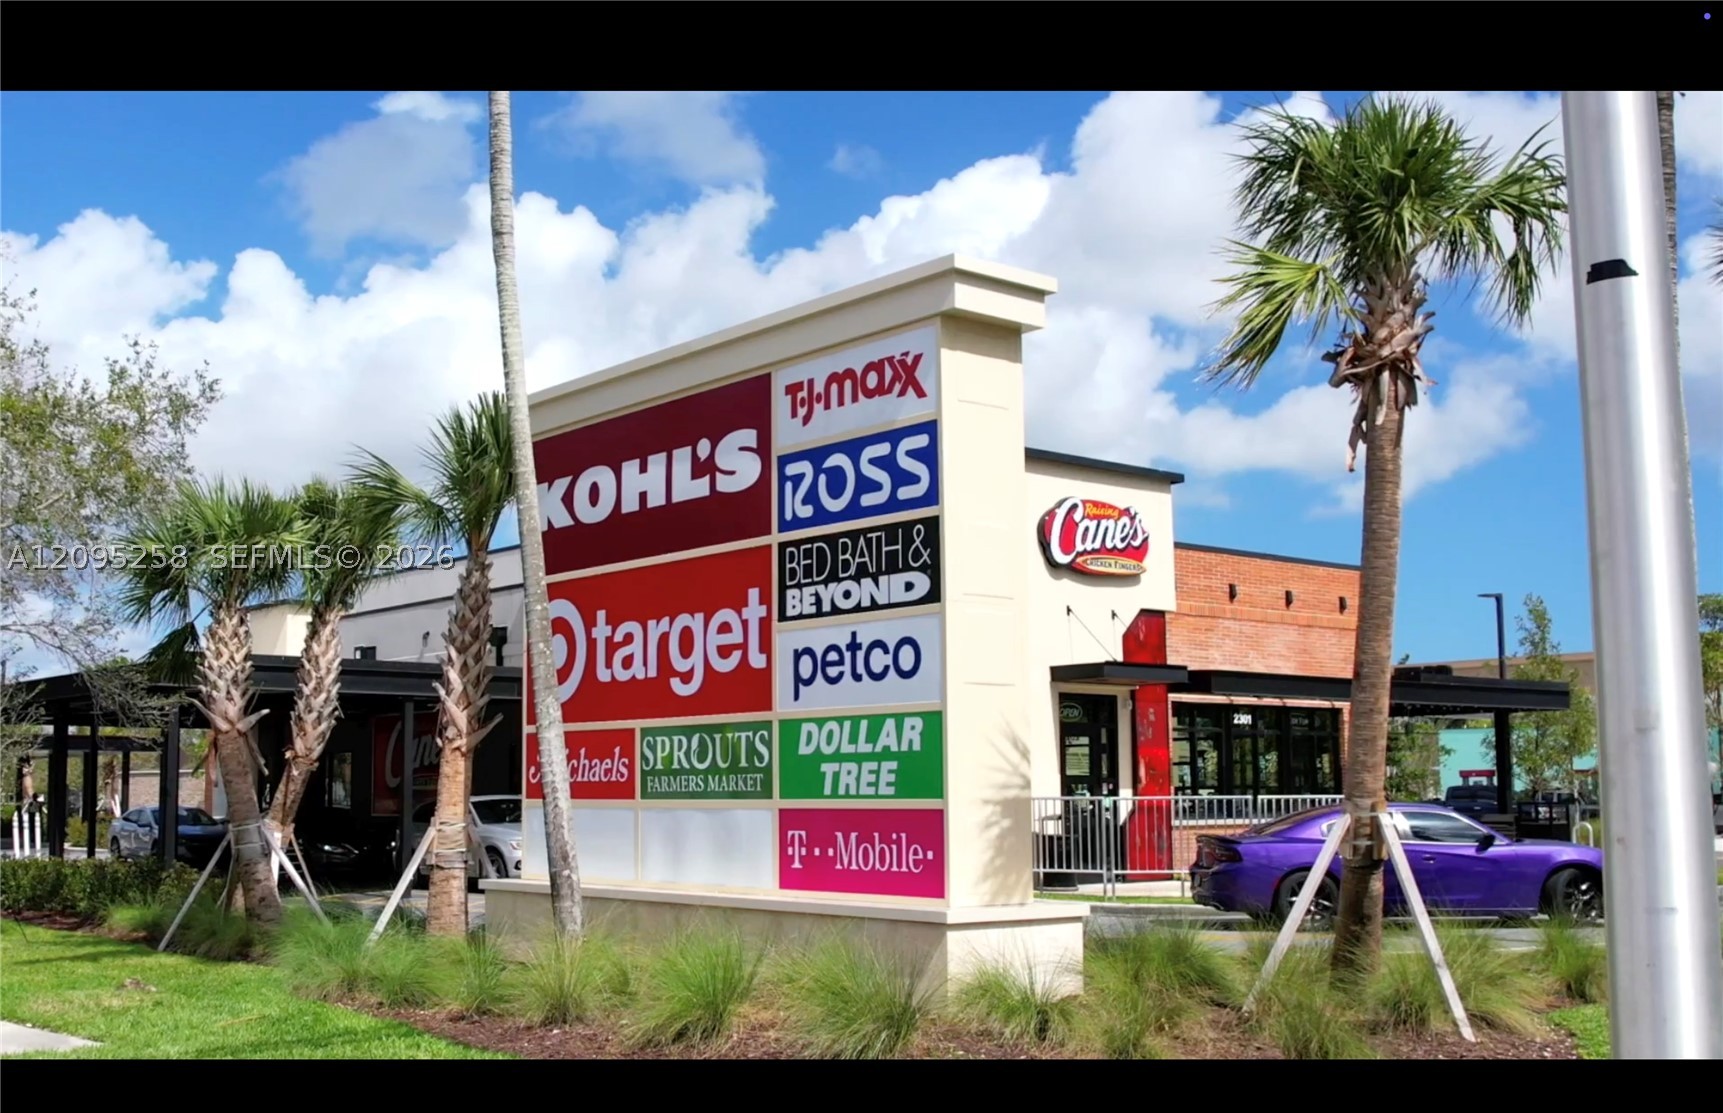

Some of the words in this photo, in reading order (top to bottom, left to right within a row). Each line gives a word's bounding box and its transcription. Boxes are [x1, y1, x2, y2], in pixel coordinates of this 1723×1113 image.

[537, 428, 762, 531] KOHL'S
[784, 433, 931, 522] ROSS
[1051, 497, 1148, 564] Cane's
[1085, 503, 1119, 520] Raising
[786, 543, 831, 586] BED
[838, 528, 902, 578] BATH
[908, 524, 931, 567] &
[786, 571, 931, 617] BEYOND
[592, 587, 767, 696] target
[793, 631, 922, 701] petco
[798, 717, 923, 756] DOLLAR
[1233, 712, 1252, 725] 2301
[529, 746, 629, 784] chaels
[642, 730, 770, 770] SPROUTS
[647, 775, 703, 793] FARMERS
[707, 773, 763, 792] MARKET
[820, 761, 898, 796] TREE
